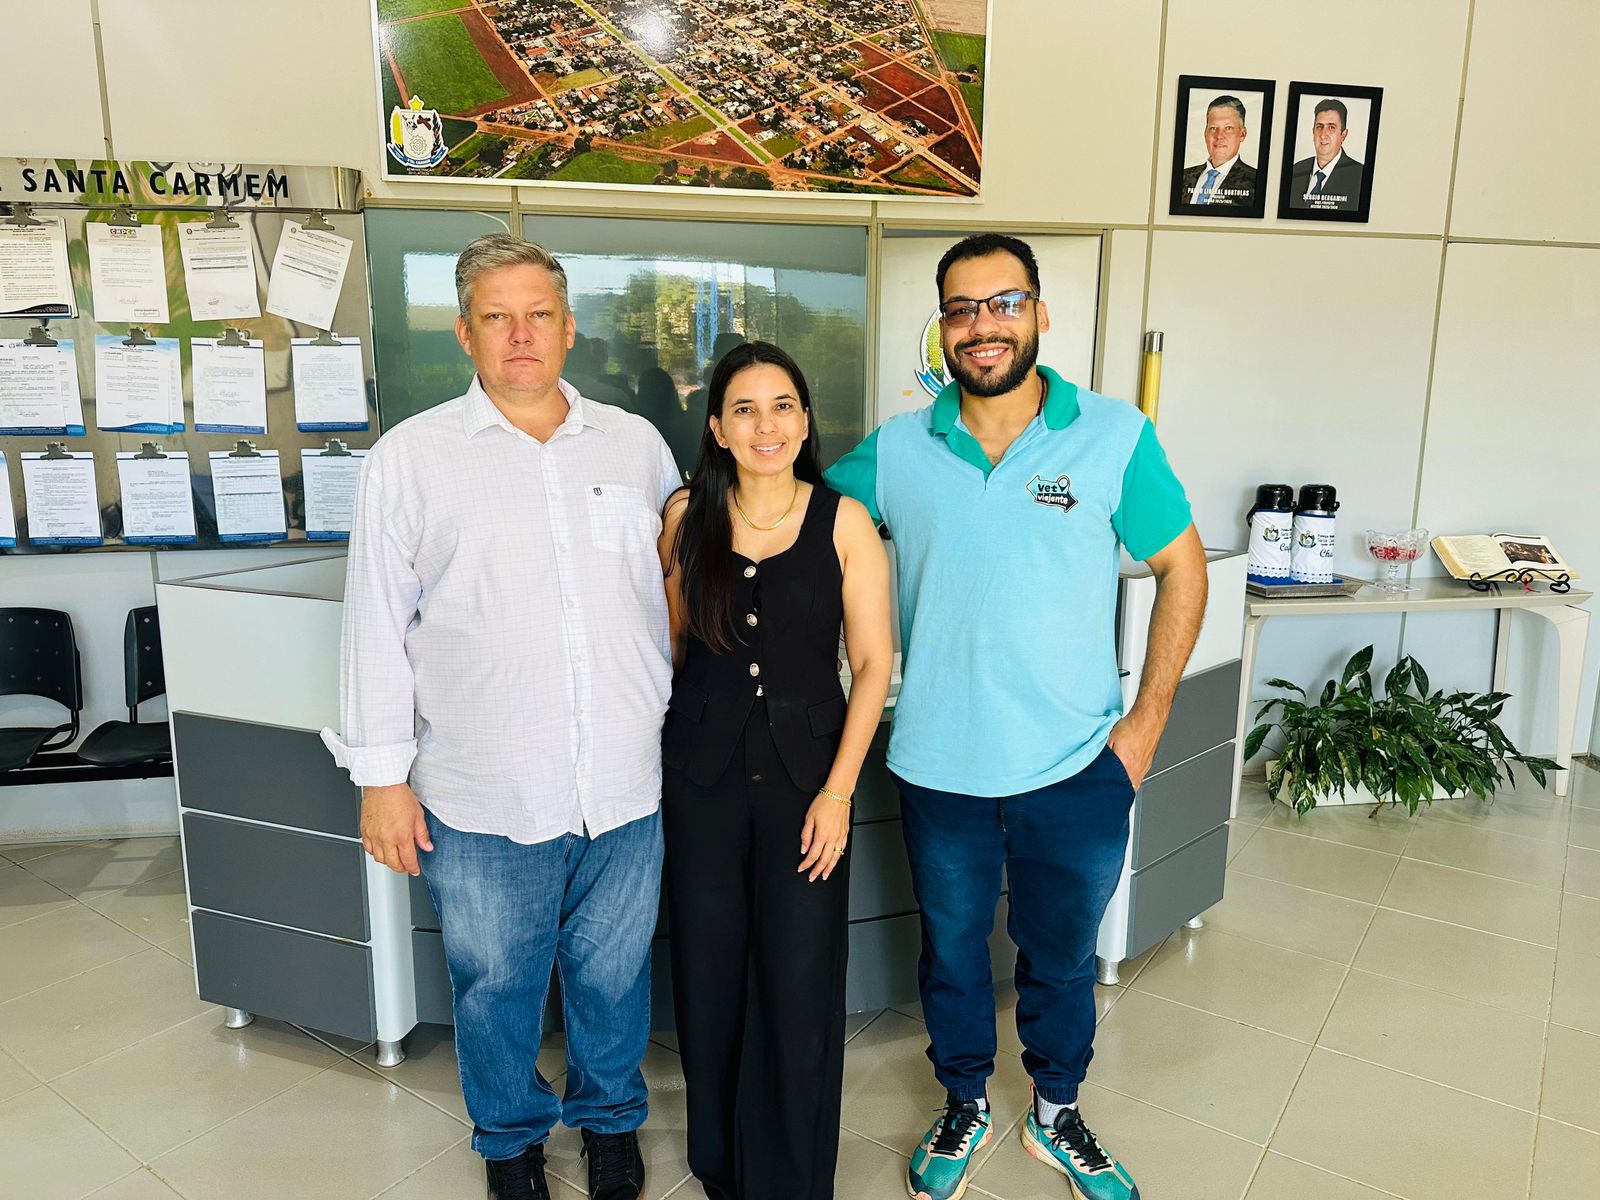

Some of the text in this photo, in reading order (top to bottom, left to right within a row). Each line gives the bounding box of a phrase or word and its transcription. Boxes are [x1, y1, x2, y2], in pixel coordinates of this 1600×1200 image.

[22, 168, 289, 198] SANTA CARMEM
[1037, 493, 1069, 505] viajante
